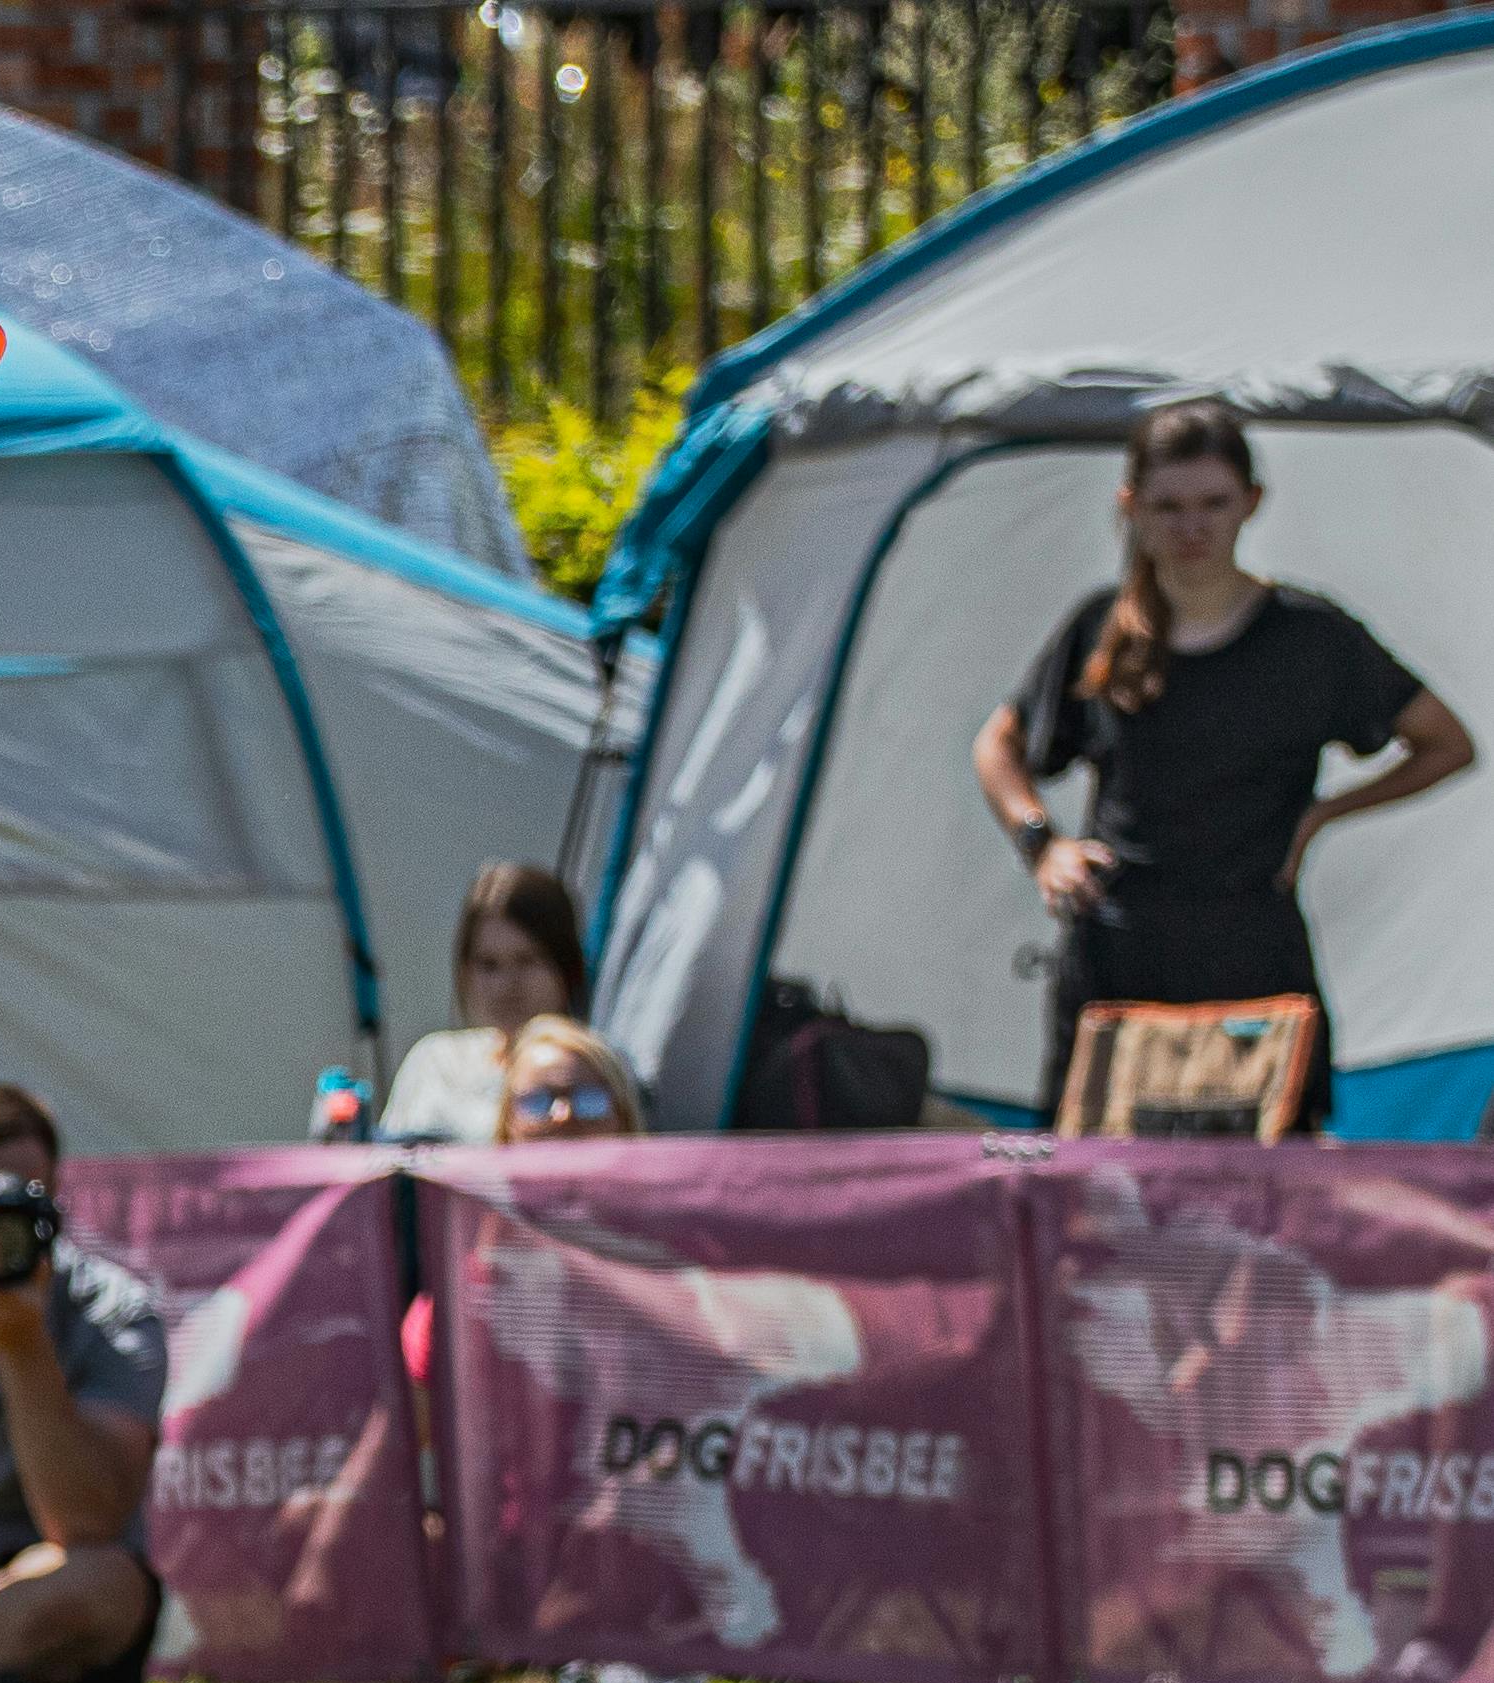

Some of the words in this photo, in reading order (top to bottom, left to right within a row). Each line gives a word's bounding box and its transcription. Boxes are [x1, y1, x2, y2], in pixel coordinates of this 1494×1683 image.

[152, 1437, 353, 1507] RISBEE
[604, 1417, 963, 1498] DOGFRISBEE
[1207, 1450, 1494, 1519] DOGFRISB
